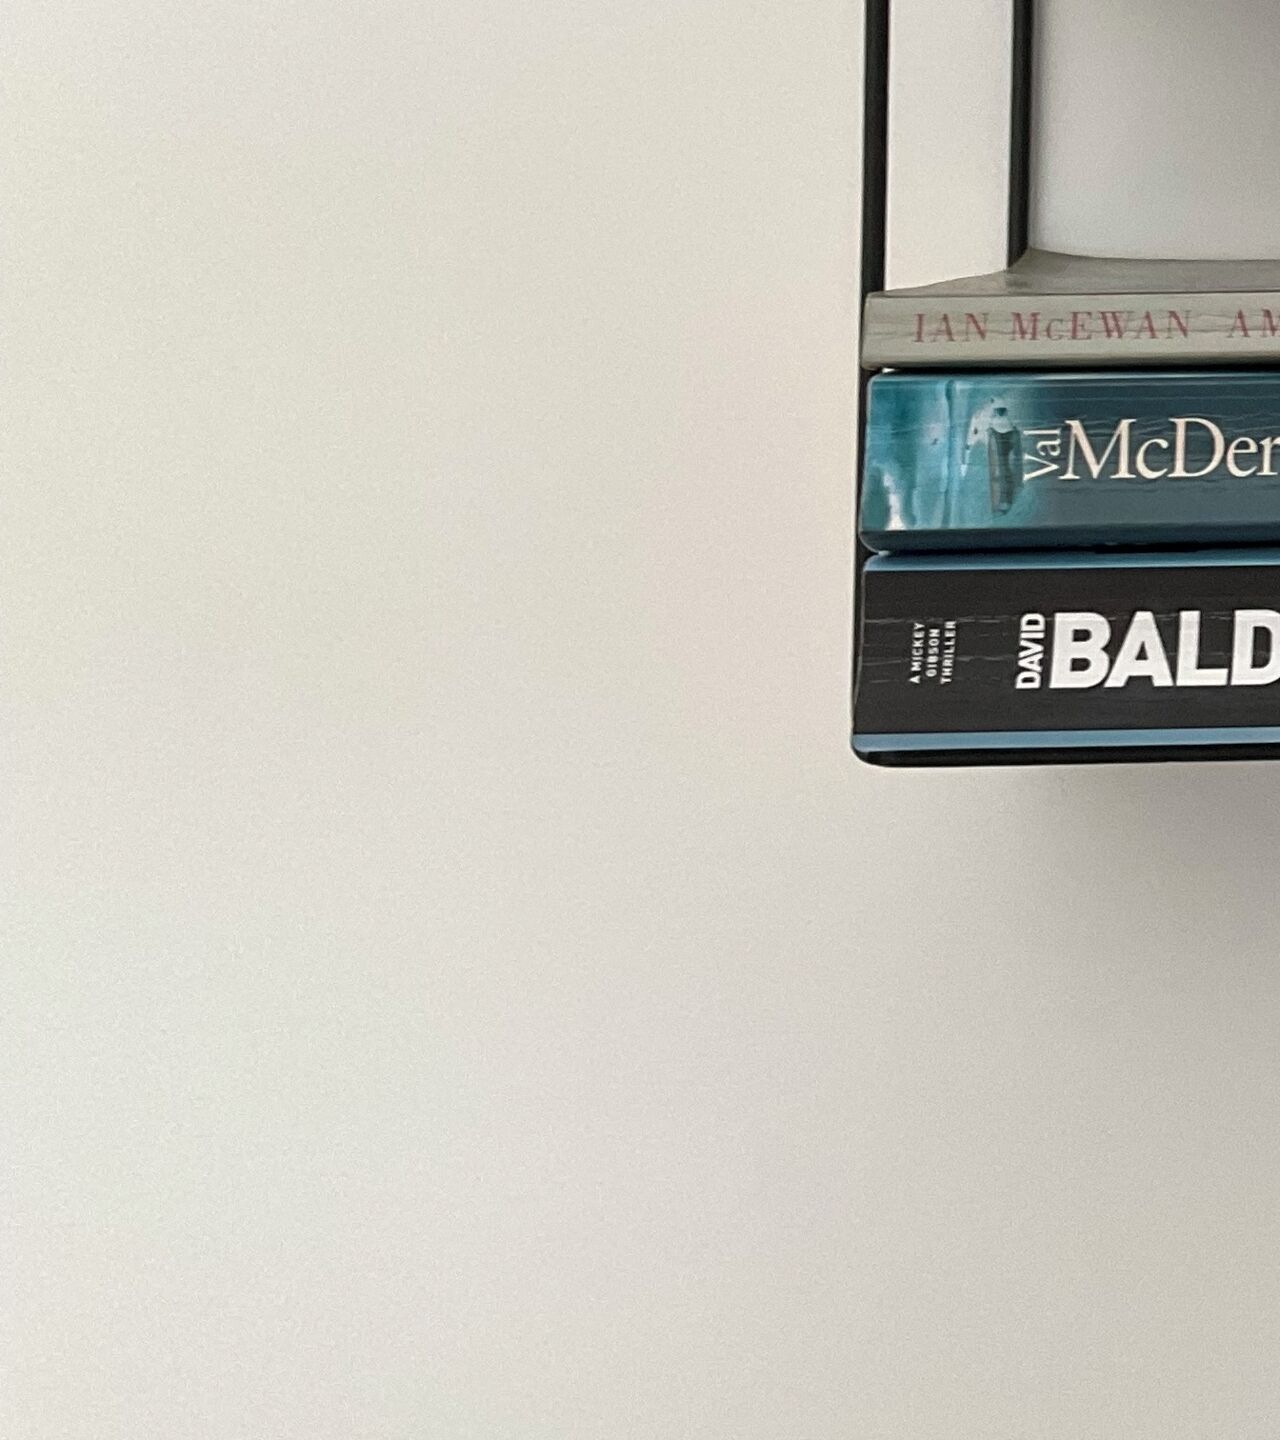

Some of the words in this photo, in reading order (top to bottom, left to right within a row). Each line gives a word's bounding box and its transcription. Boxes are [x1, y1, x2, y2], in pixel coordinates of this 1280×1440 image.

[914, 311, 990, 343] IAN
[1023, 428, 1061, 481] Val
[910, 622, 924, 672] MICKEY
[925, 627, 940, 677] GIBSON
[940, 620, 957, 684] THRILLER
[1014, 611, 1046, 690] DAVID
[909, 674, 921, 684] A
